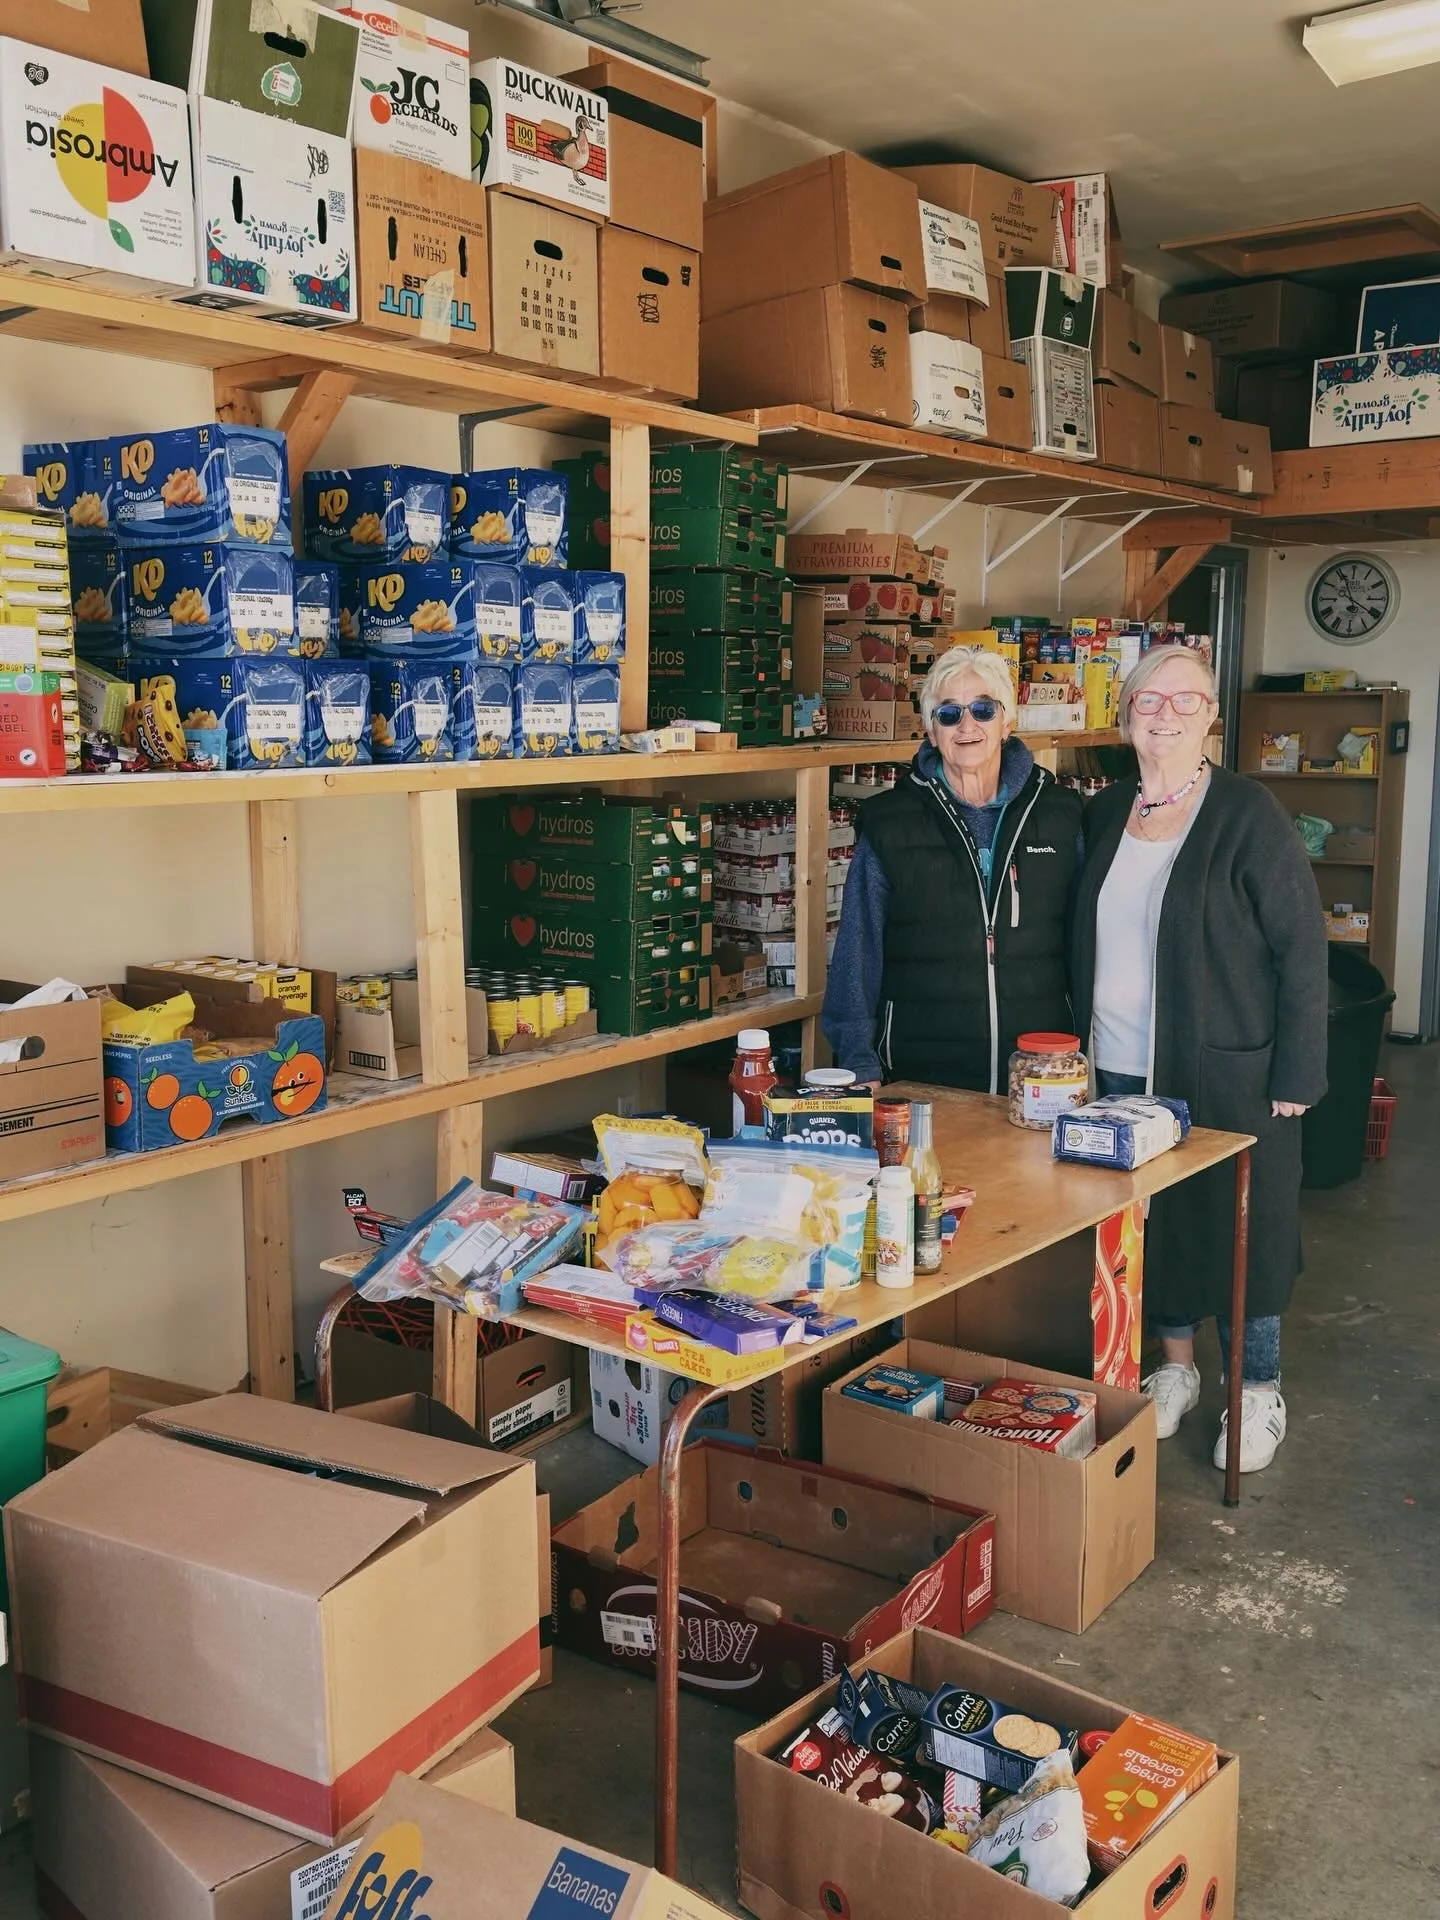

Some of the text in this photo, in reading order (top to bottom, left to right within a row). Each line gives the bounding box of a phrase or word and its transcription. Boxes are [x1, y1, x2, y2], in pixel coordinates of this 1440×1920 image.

[369, 15, 402, 35] Ceceli
[390, 67, 440, 113] JC
[504, 65, 605, 123] DUCKWALL
[504, 88, 523, 103] PEARS
[25, 104, 85, 127] Sweet Perfection
[517, 125, 533, 141] 100
[517, 138, 533, 148] YEARS
[26, 120, 179, 187] Ambrosia
[259, 220, 287, 233] grown
[250, 227, 306, 258] joyfully
[413, 233, 446, 246] FRESH
[413, 243, 446, 264] CHELAN
[558, 296, 564, 307] 72
[545, 322, 553, 334] 175
[1355, 394, 1390, 410] grown
[1341, 401, 1415, 433] joyfully
[199, 430, 209, 443] 12
[104, 457, 112, 470] 12
[120, 439, 155, 485] KD
[35, 463, 67, 501] KD
[383, 480, 392, 493] 12
[508, 478, 518, 491] 12
[124, 487, 156, 501] ORIGINAL
[318, 487, 349, 525] KD
[319, 525, 348, 537] ORIGINAL
[812, 542, 874, 555] PREMIUM
[105, 552, 116, 567] 12
[203, 551, 213, 564] 12
[796, 555, 890, 569] STRAWBERRIES
[134, 558, 165, 601] KD
[450, 566, 461, 580] 12
[367, 572, 406, 612] KD
[649, 586, 685, 604] dros
[135, 603, 165, 618] ORIGINAL
[370, 613, 405, 627] ORIGINAL
[649, 647, 685, 665] dros
[220, 674, 232, 690] 12
[390, 682, 401, 695] 12
[650, 703, 687, 721] dros
[827, 708, 871, 719] EMIUM
[828, 721, 888, 734] WBERRIES
[538, 812, 594, 836] hydros
[540, 868, 595, 892] hydros
[540, 924, 595, 948] hydros
[278, 984, 301, 993] orange
[278, 991, 308, 1000] beverage
[145, 1053, 173, 1064] SEEDLESS
[0, 1116, 35, 1133] GEMENT
[662, 1303, 683, 1324] FINGERS
[684, 1348, 705, 1364] TEA
[680, 1356, 712, 1378] CAKES
[492, 1402, 532, 1429] simply paper
[630, 1406, 638, 1425] big
[492, 1412, 533, 1440] papier simply
[945, 1692, 976, 1730] Carr's
[960, 1699, 986, 1733] Cheese Melts
[876, 1715, 910, 1752] Carr's
[1124, 1748, 1184, 1777] cereals
[1124, 1762, 1176, 1788] dorset
[548, 1862, 618, 1915] Bananas
